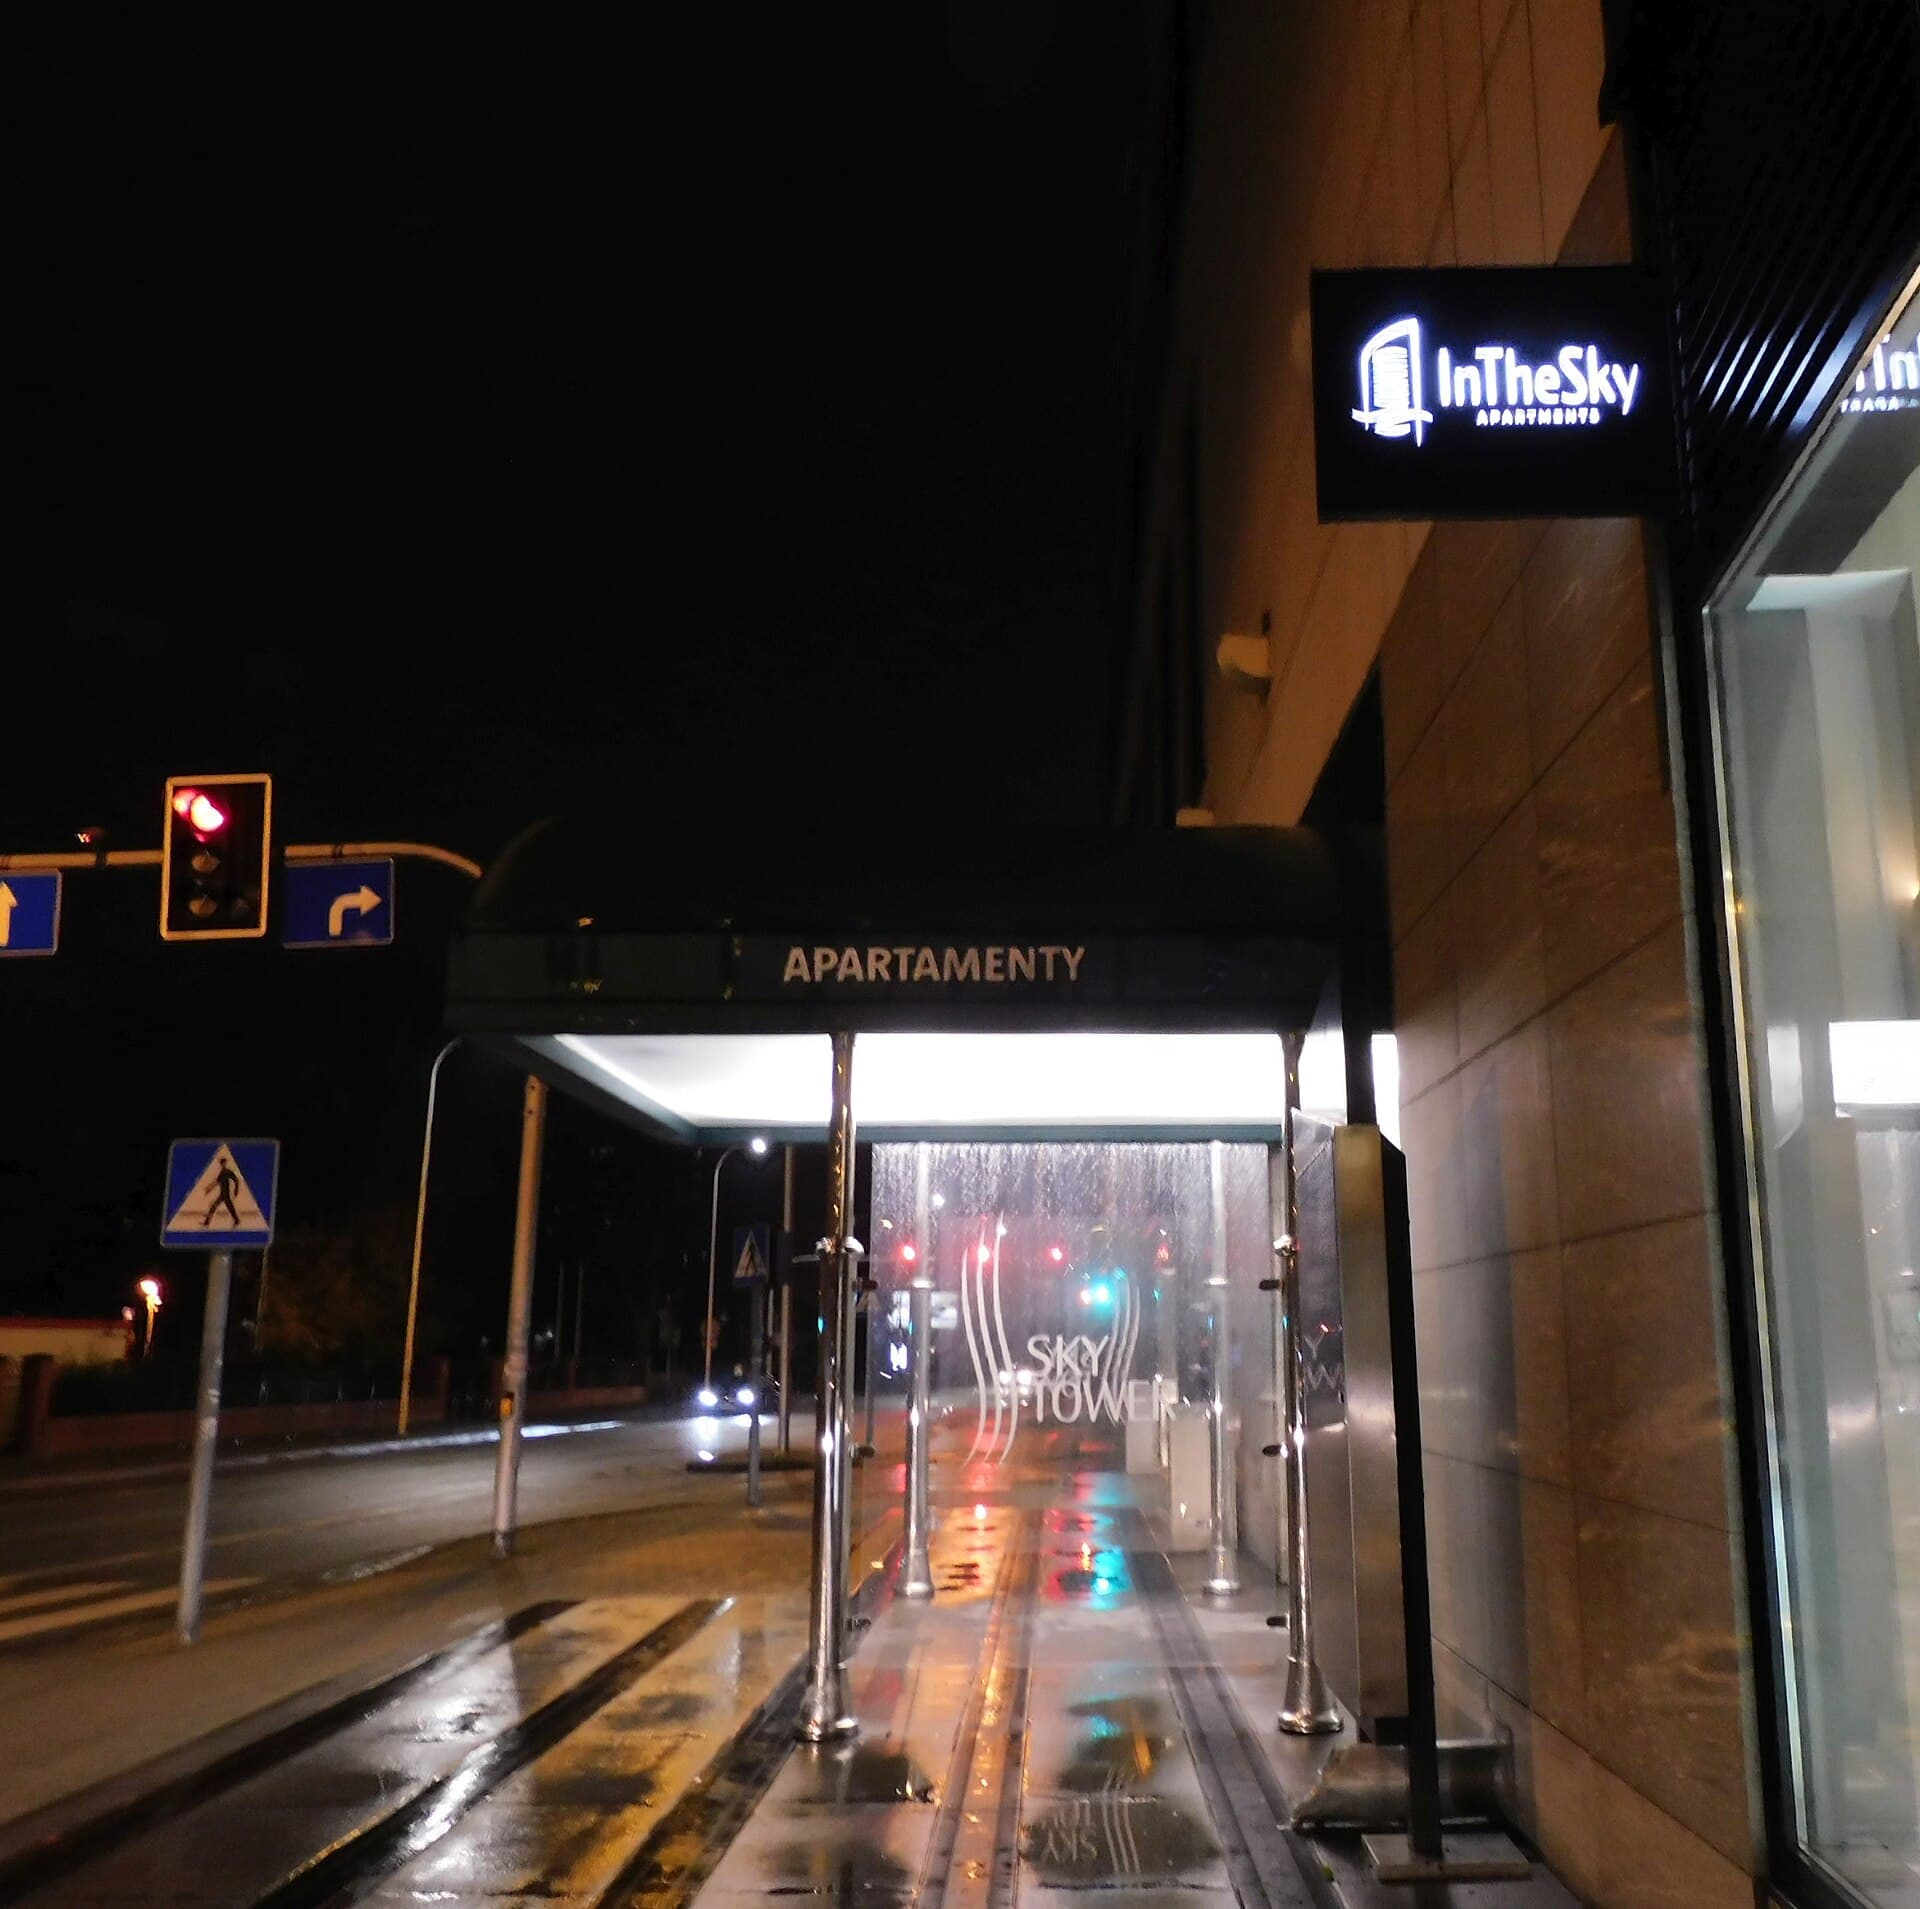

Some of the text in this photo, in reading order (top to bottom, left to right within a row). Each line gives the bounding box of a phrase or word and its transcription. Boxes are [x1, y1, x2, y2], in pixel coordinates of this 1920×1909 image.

[1438, 345, 1639, 416] InTheSky
[1475, 407, 1600, 427] APARTMENTS
[783, 946, 1086, 983] APARTAMENTY
[1028, 1334, 1110, 1377] SKY
[1032, 1378, 1177, 1424] TOWER
